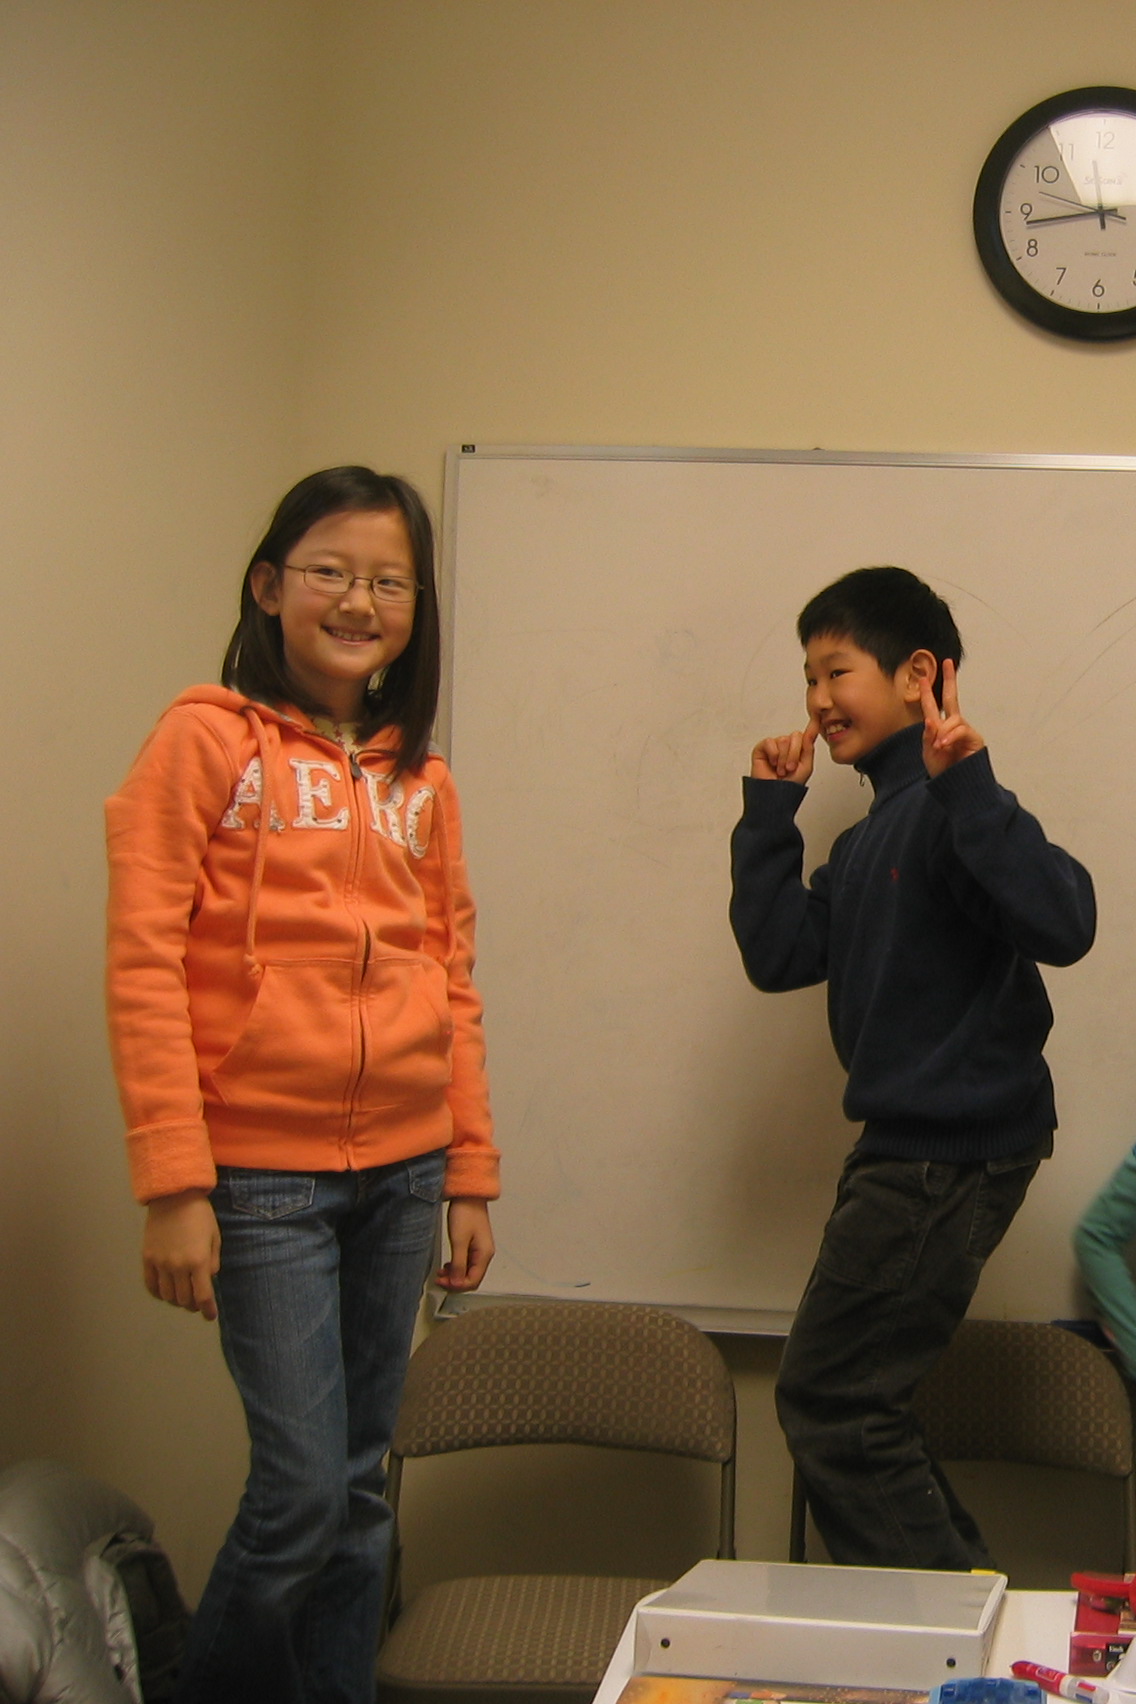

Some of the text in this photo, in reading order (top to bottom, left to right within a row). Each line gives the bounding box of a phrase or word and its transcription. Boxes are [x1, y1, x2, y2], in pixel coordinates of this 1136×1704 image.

[1096, 131, 1116, 150] 12
[1059, 143, 1075, 161] 11
[1034, 165, 1060, 184] 10
[1019, 202, 1034, 221] 9
[1026, 238, 1039, 258] 8
[1055, 267, 1067, 286] 7
[1091, 278, 1105, 298] 6
[221, 756, 436, 859] AERO
